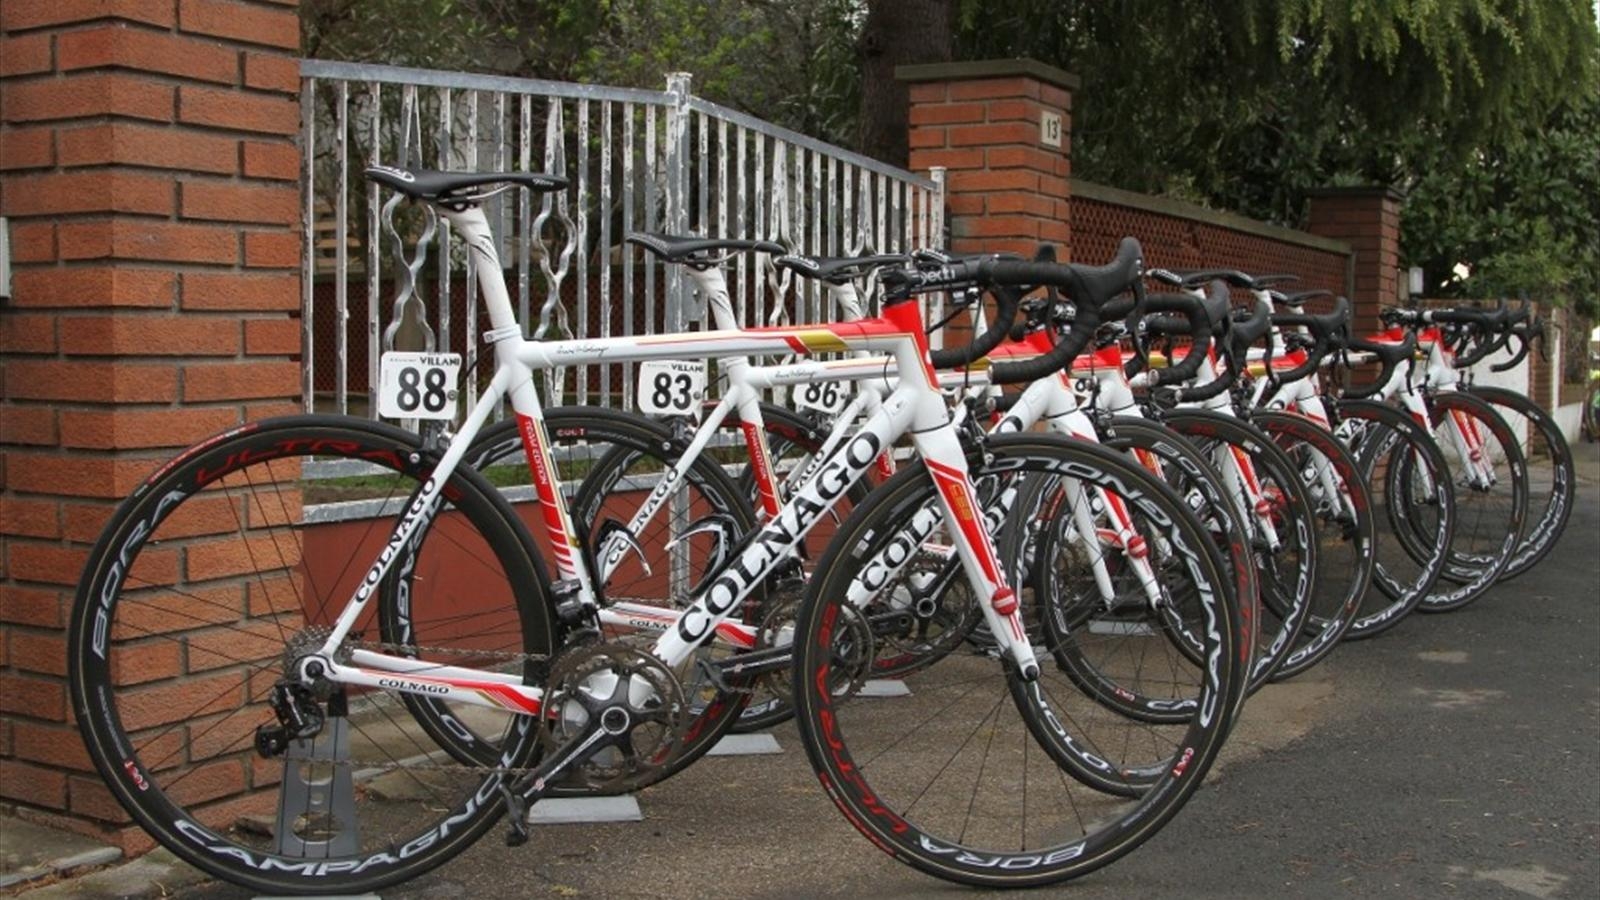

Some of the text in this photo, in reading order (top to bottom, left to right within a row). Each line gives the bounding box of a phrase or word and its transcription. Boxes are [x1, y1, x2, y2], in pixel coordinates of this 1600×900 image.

[1046, 119, 1058, 140] 13
[420, 356, 460, 368] VILLANI
[396, 366, 447, 413] 88
[652, 371, 693, 410] 83
[805, 380, 841, 409] 86
[556, 427, 586, 438] CULT
[1151, 440, 1233, 535] BORA
[92, 488, 187, 661] BORA
[194, 437, 407, 487] ULTRA
[355, 476, 436, 604] COLNAGO
[678, 431, 881, 644] COLNAGO
[978, 455, 1221, 728] CAMPAGNOLO
[629, 619, 671, 630] COLNA
[378, 678, 450, 695] COLNAGO
[816, 663, 908, 834] ULTRA
[919, 833, 1087, 870] BORA
